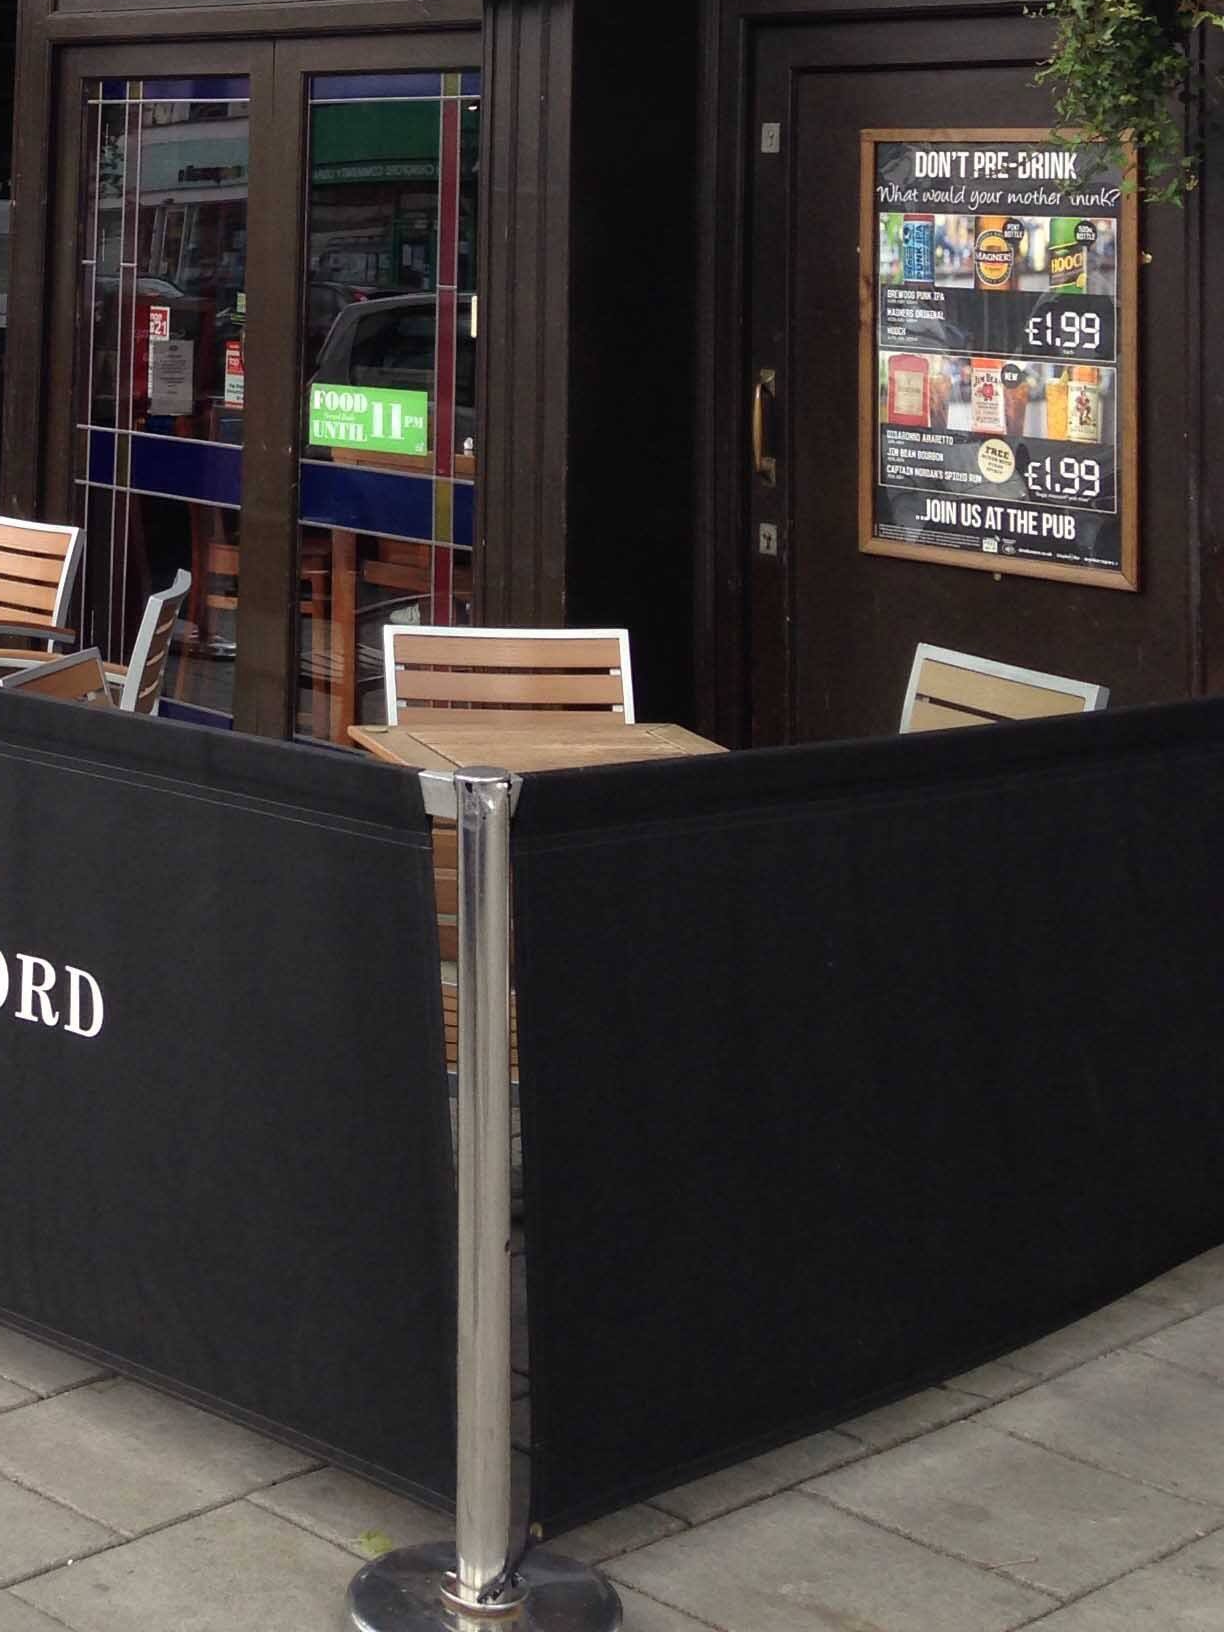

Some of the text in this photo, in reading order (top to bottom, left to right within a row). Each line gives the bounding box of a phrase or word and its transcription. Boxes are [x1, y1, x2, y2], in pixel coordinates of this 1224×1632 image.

[915, 151, 1078, 179] DON'T PRE-DRINK
[877, 183, 919, 203] What
[923, 185, 966, 204] would
[968, 191, 1004, 210] your
[1008, 187, 1061, 206] mother
[1051, 253, 1084, 273] HOOC
[1024, 311, 1100, 349] £1.99
[313, 389, 369, 414] FOOD
[312, 419, 368, 442] UNTIL
[371, 401, 424, 440] 11 PM
[984, 446, 1010, 459] FREE
[1024, 457, 1100, 496] £1.99
[960, 503, 982, 528] US
[984, 506, 1007, 531] AT
[1008, 508, 1039, 536] THE
[1042, 514, 1076, 540] PUB
